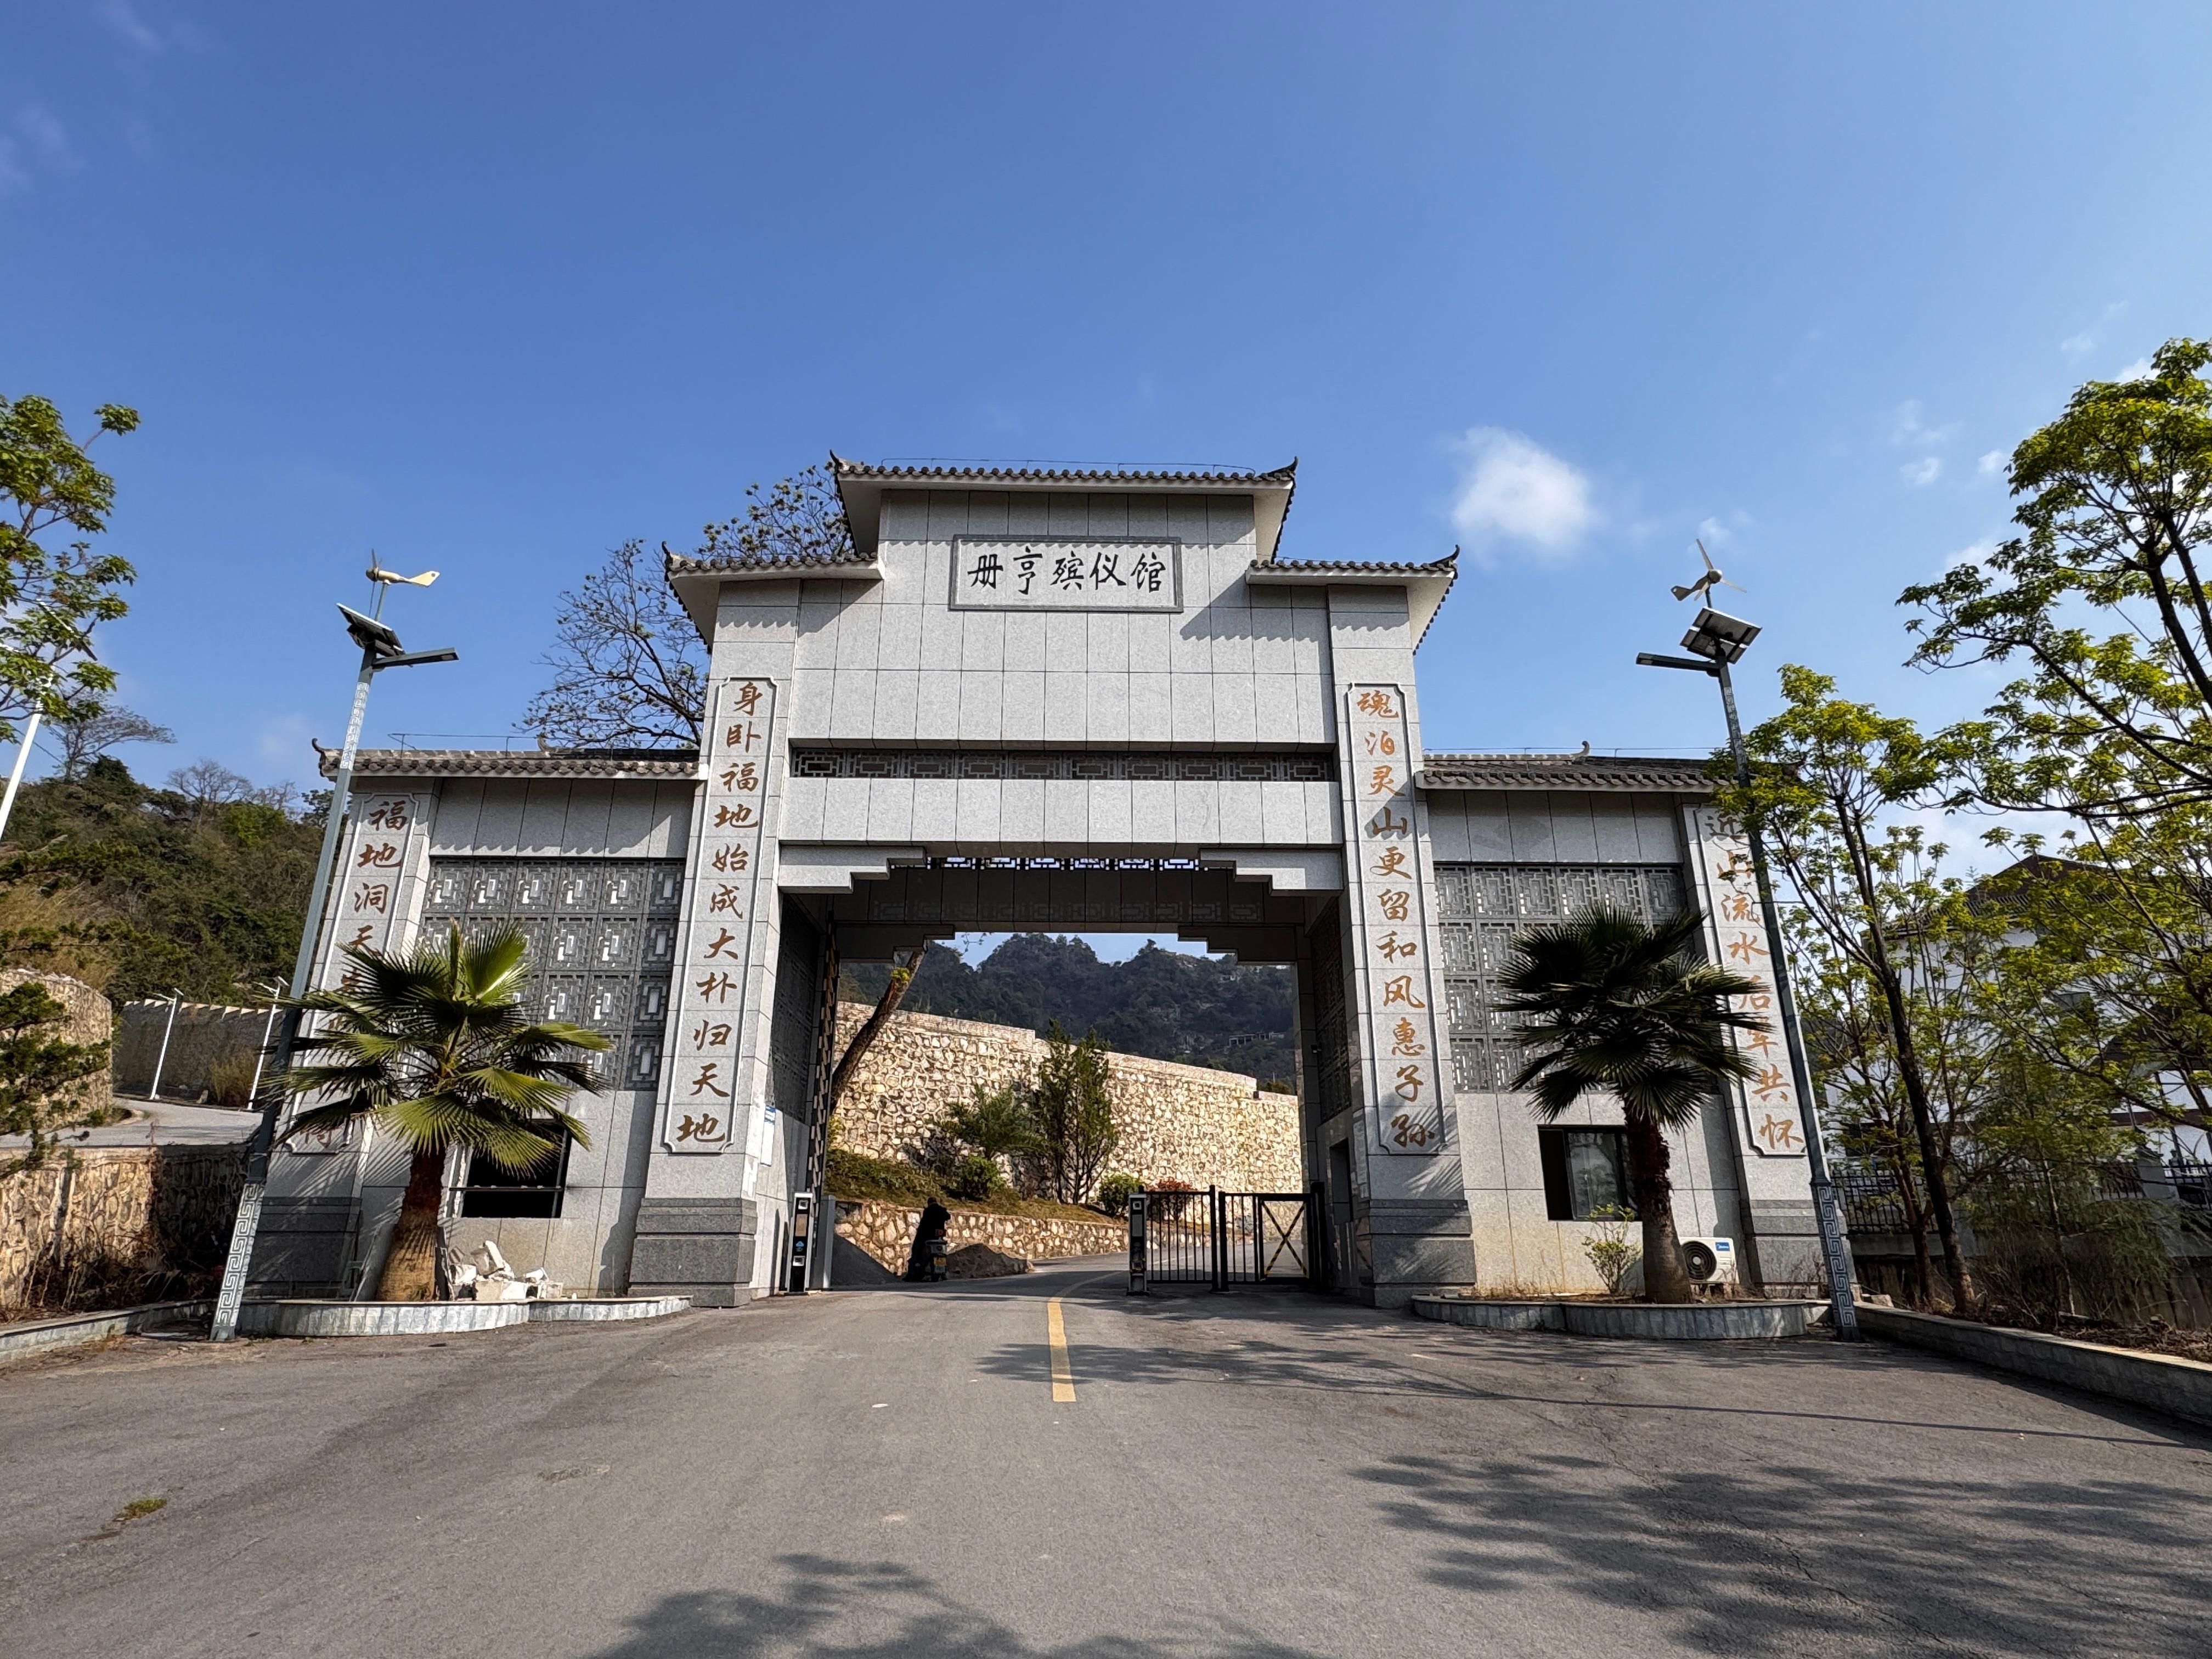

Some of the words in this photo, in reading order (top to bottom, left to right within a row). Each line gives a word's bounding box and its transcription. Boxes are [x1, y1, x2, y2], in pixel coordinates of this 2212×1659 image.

[967, 546, 1166, 595] 册亨殡仪馆
[676, 681, 763, 1143] 身卧福地始成大朴归天地
[1356, 690, 1435, 1147] 魂泊灵山更留和风惠子孙
